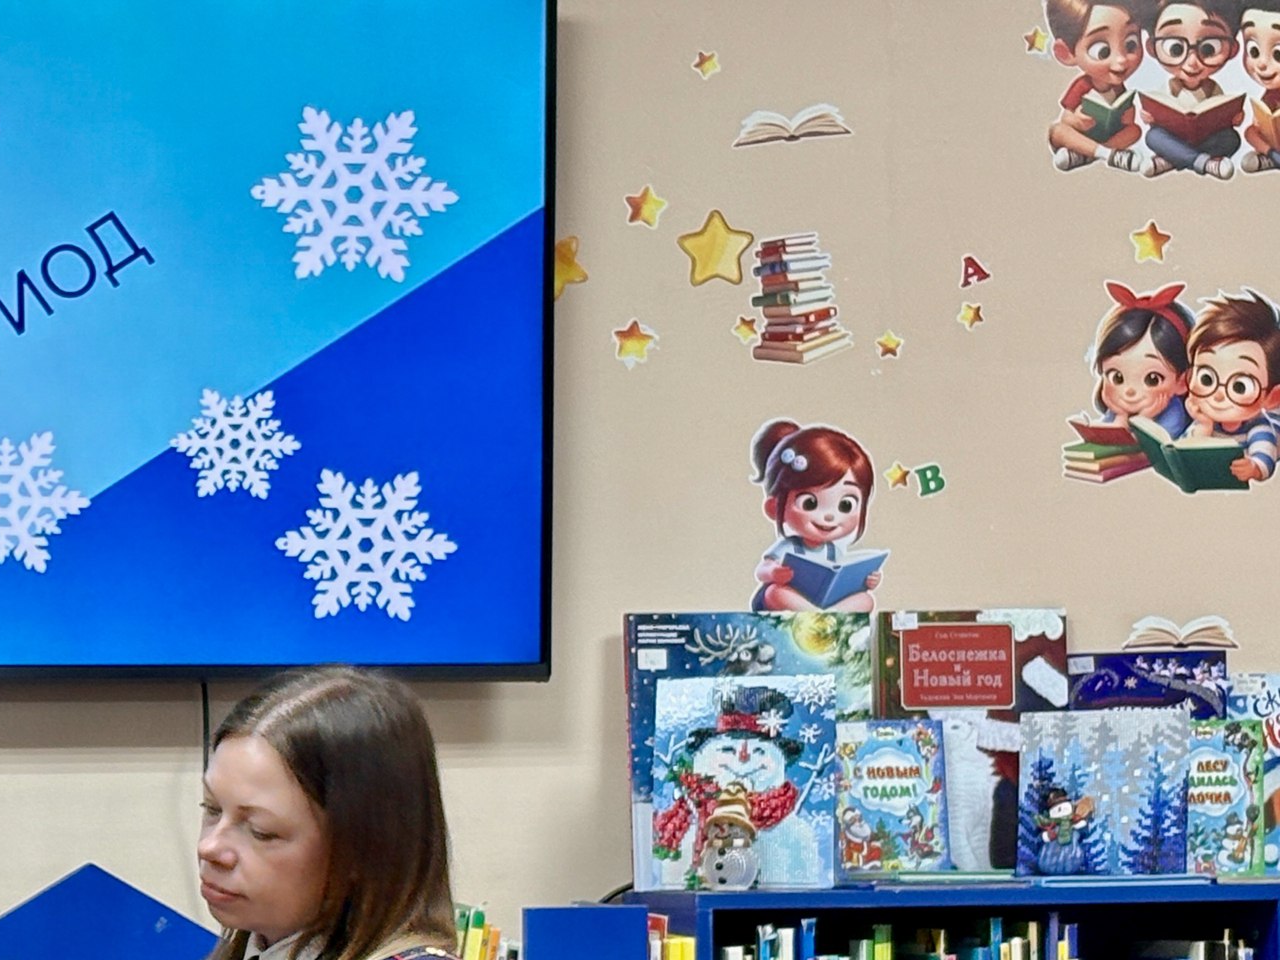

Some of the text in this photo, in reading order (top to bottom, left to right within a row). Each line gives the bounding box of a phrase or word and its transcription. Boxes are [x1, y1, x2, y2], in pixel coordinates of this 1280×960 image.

[908, 644, 1007, 662] Белоснежка
[913, 669, 1002, 688] Новый год
[867, 767, 921, 779] НОВЫМ
